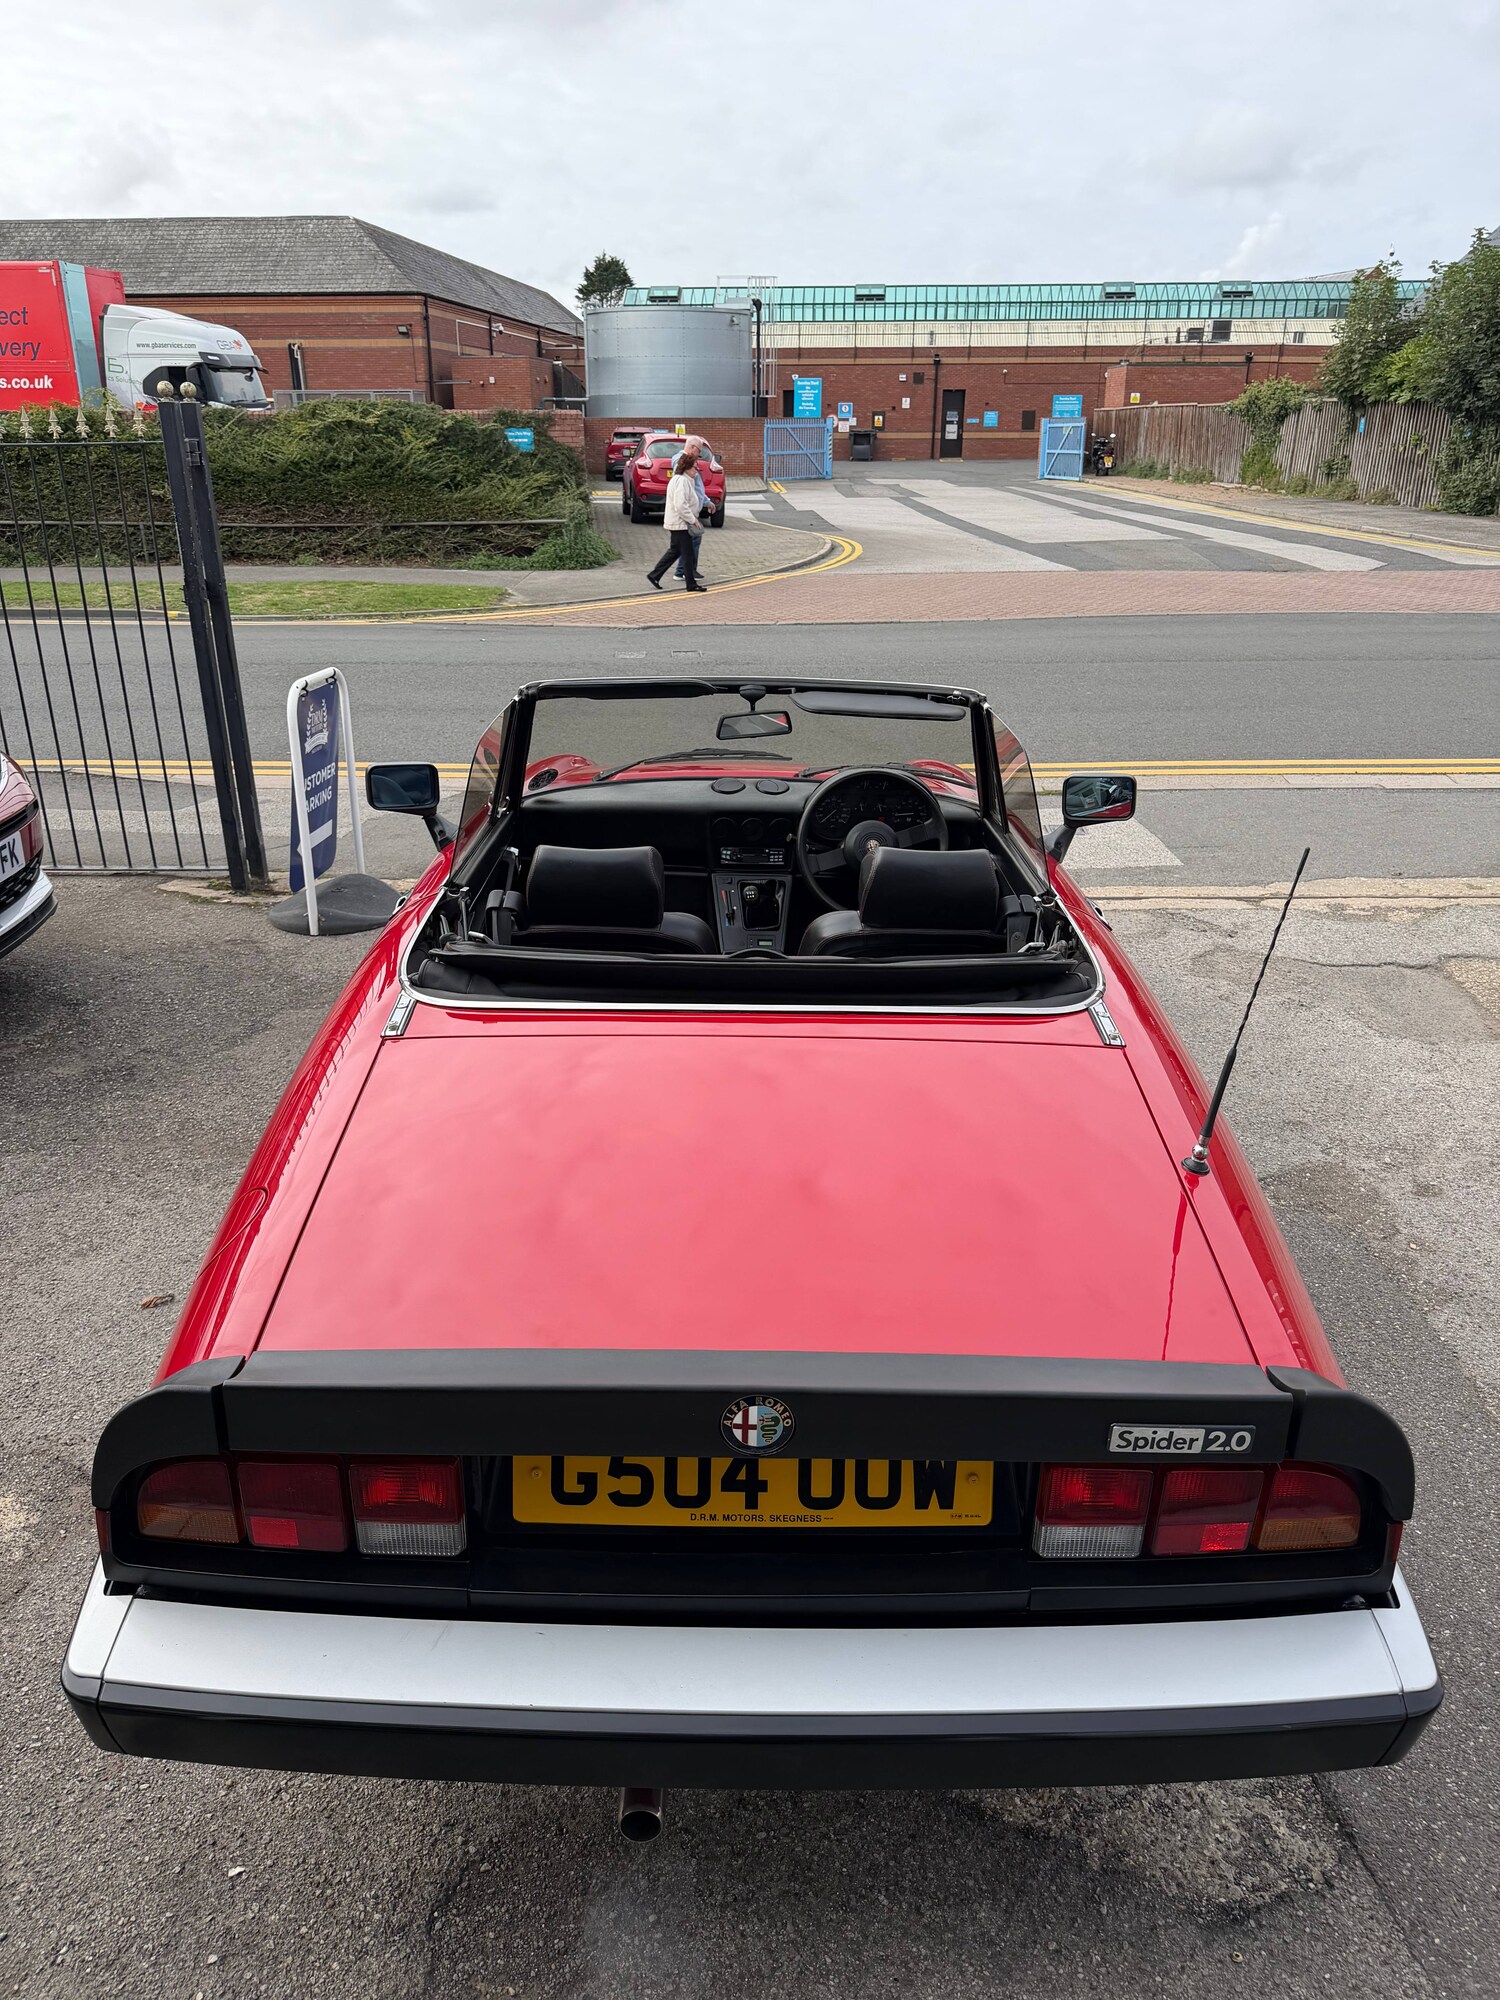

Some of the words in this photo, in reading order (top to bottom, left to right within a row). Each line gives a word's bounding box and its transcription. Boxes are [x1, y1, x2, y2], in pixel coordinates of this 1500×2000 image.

[136, 342, 197, 350] www.gbaservices.com
[0, 375, 53, 389] s.co.uk
[304, 762, 336, 792] STOMER
[305, 786, 332, 813] ARKING
[723, 1399, 748, 1427] ALFA
[755, 1396, 792, 1427] ROMEO
[1115, 1430, 1199, 1451] Spider
[1206, 1431, 1252, 1451] 2.0
[690, 1513, 720, 1521] D.R.M.
[722, 1514, 767, 1522] MOTORS.
[769, 1514, 822, 1523] SKEGNESS
